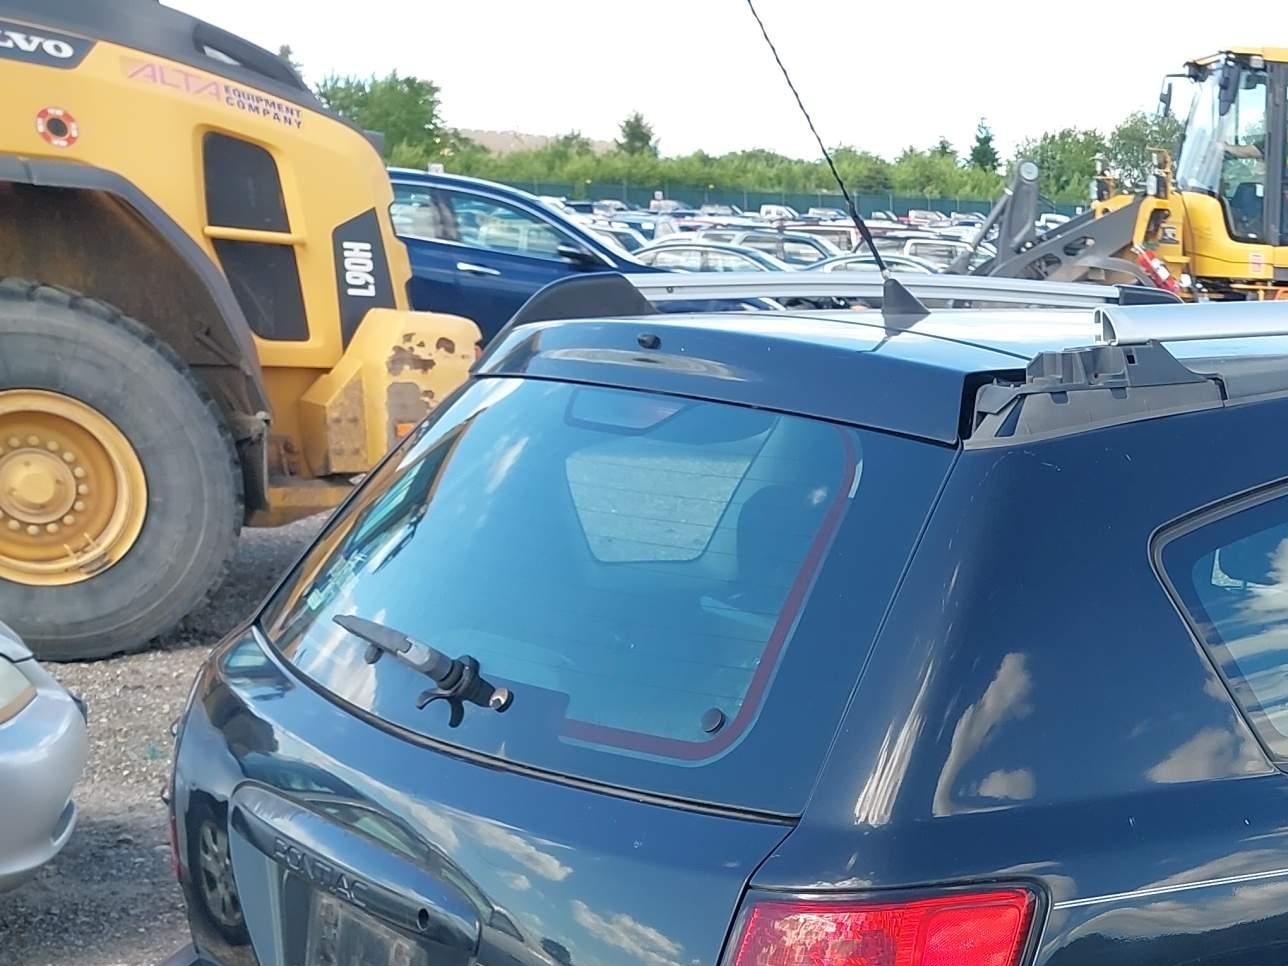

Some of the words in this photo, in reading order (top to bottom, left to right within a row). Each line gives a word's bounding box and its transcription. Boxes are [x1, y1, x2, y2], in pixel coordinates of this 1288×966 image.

[127, 63, 221, 101] ALTA
[223, 85, 303, 118] EQUIPMENT
[225, 96, 303, 129] COMPANY
[342, 241, 376, 297] L90H
